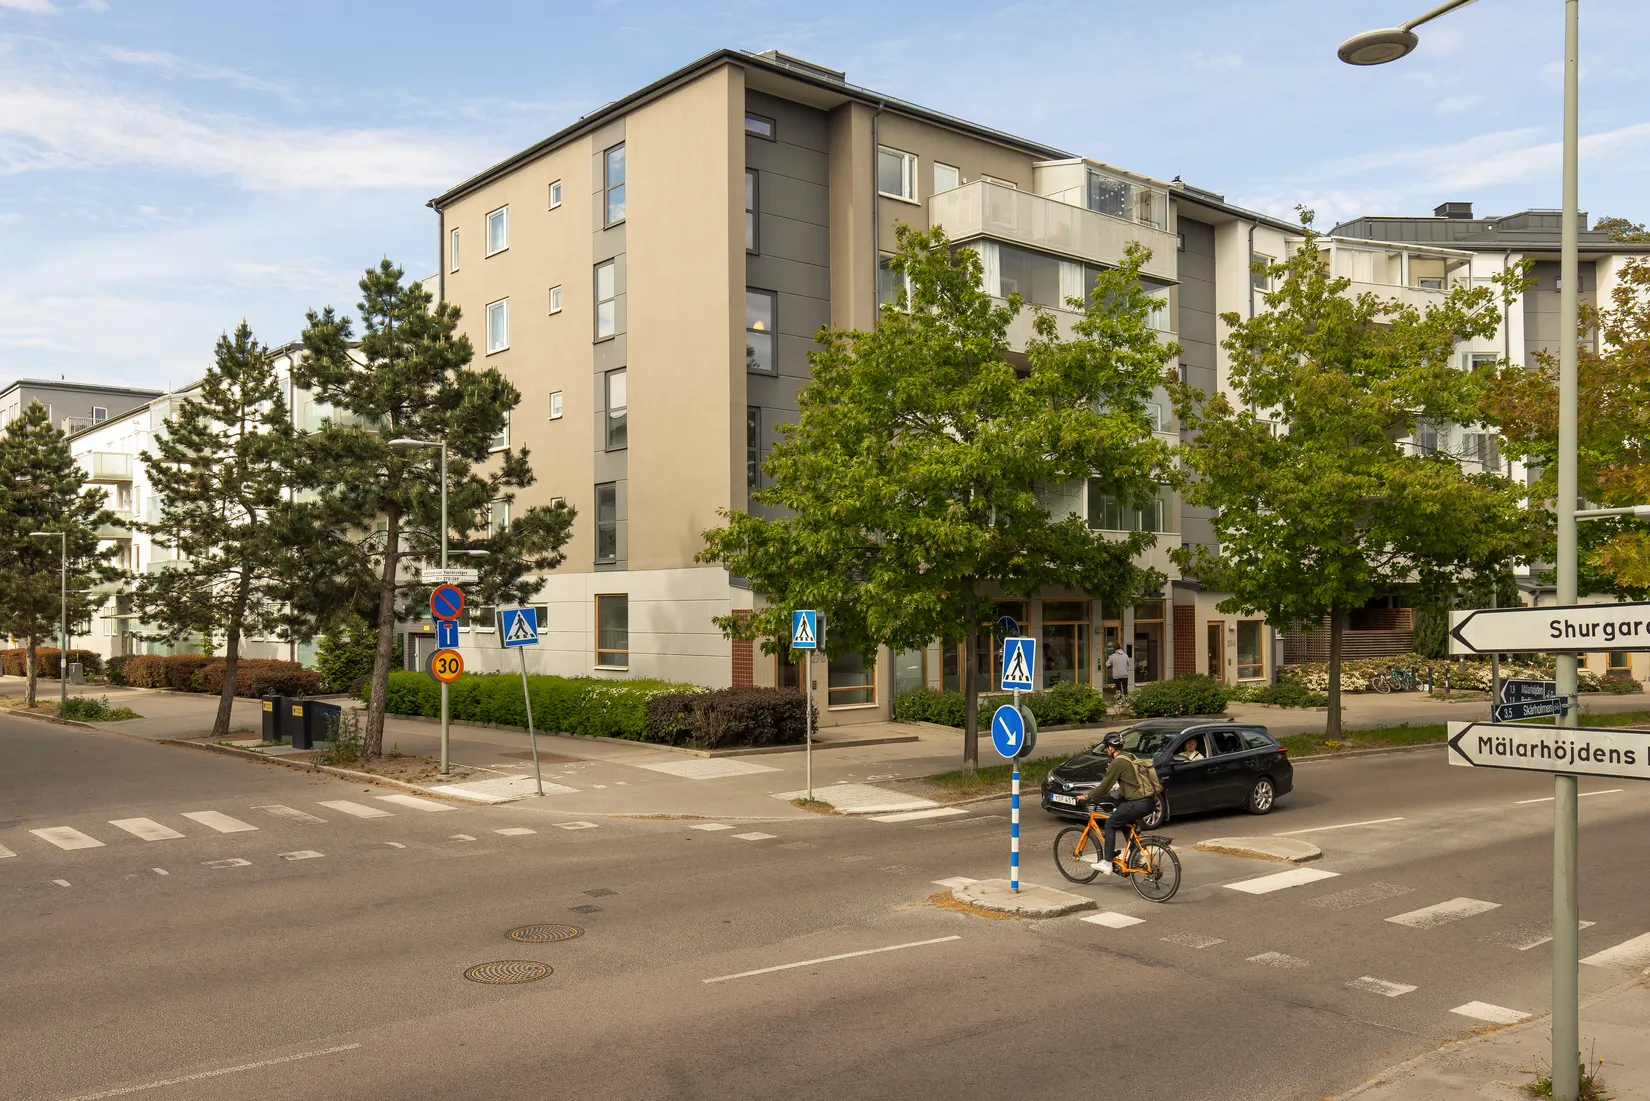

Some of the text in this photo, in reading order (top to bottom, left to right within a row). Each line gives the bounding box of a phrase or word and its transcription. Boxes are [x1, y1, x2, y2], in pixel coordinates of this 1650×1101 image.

[1549, 619, 1650, 642] Shurgar
[437, 657, 459, 674] 30
[1503, 703, 1553, 719] 3,5 Skärholmen
[1478, 736, 1636, 766] Mälarhöjdens
